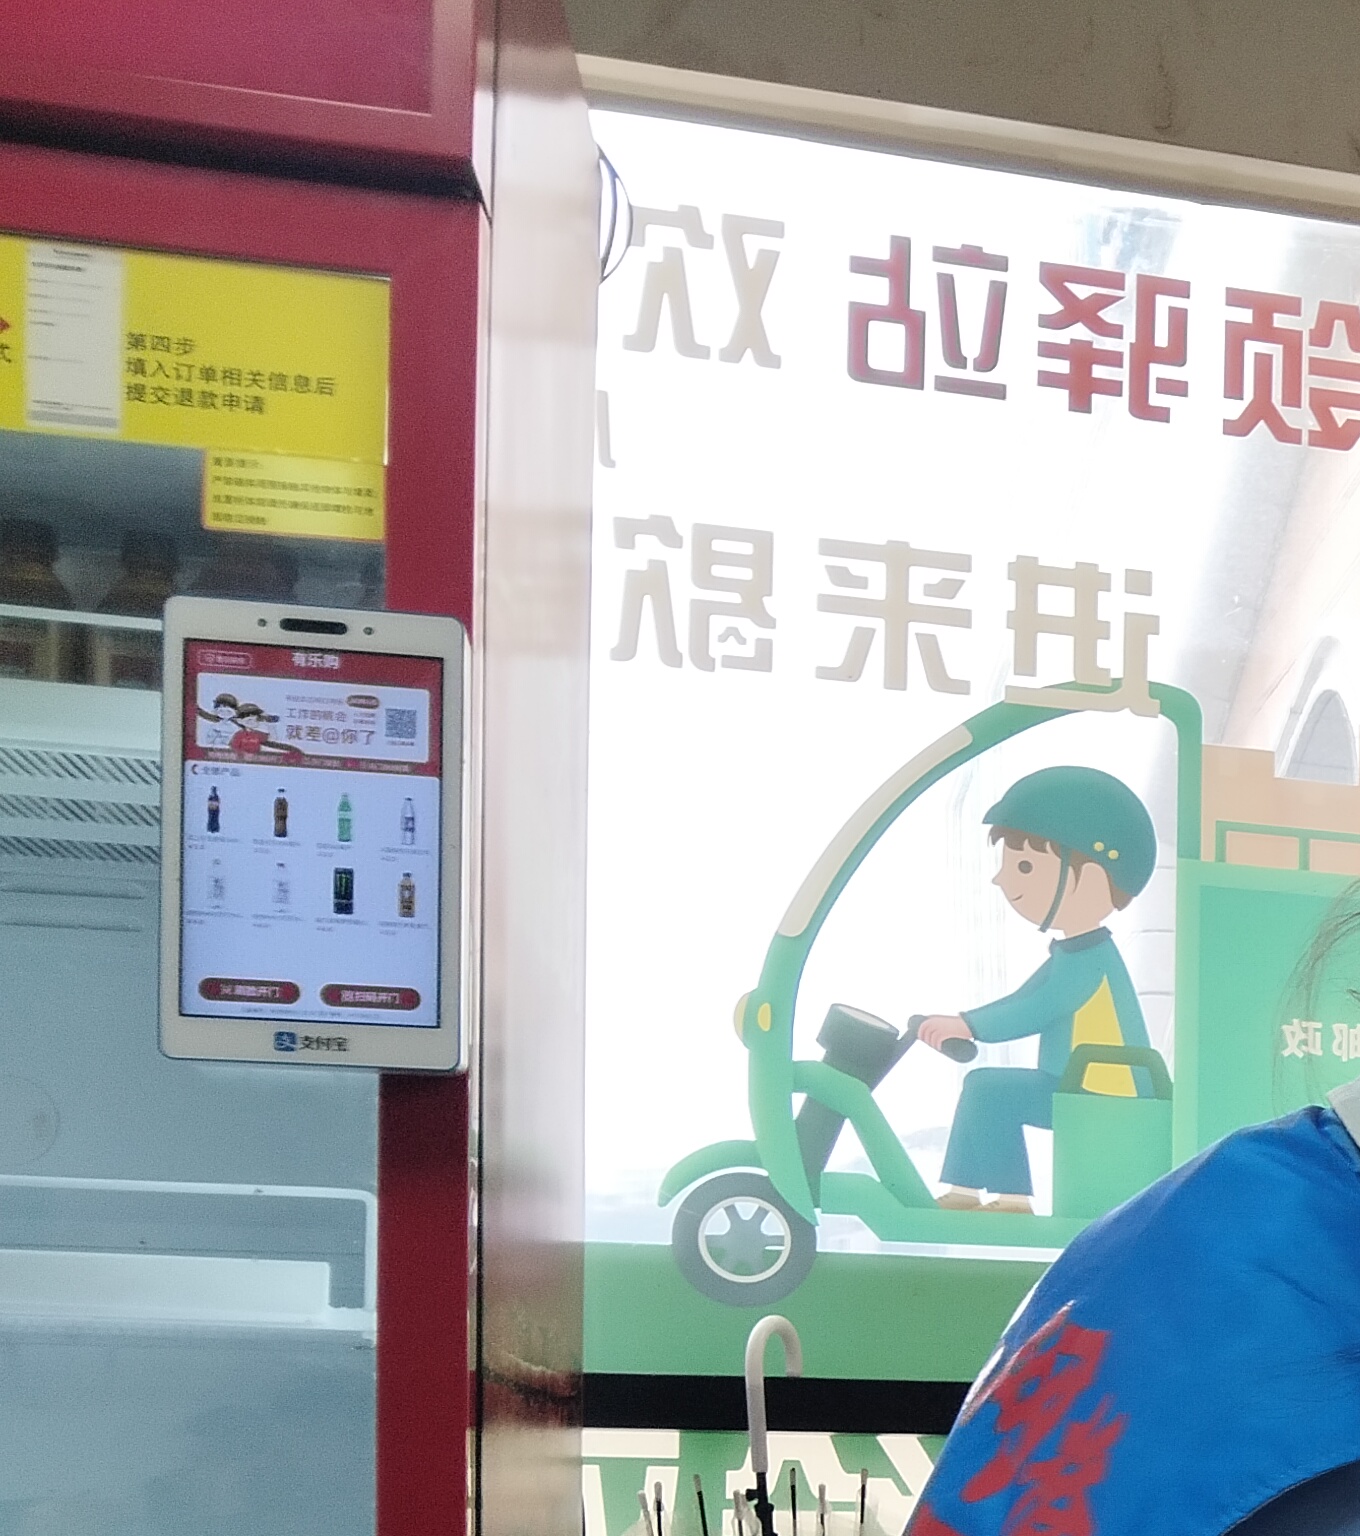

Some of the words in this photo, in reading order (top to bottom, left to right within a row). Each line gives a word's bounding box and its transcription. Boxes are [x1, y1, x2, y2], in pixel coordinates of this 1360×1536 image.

[126, 331, 196, 356] 第四步
[125, 356, 336, 396] 填入订单相关信息后
[125, 384, 267, 415] 提交退款申请
[286, 725, 376, 745] 就差@你了
[299, 1035, 349, 1052] 支付宝
